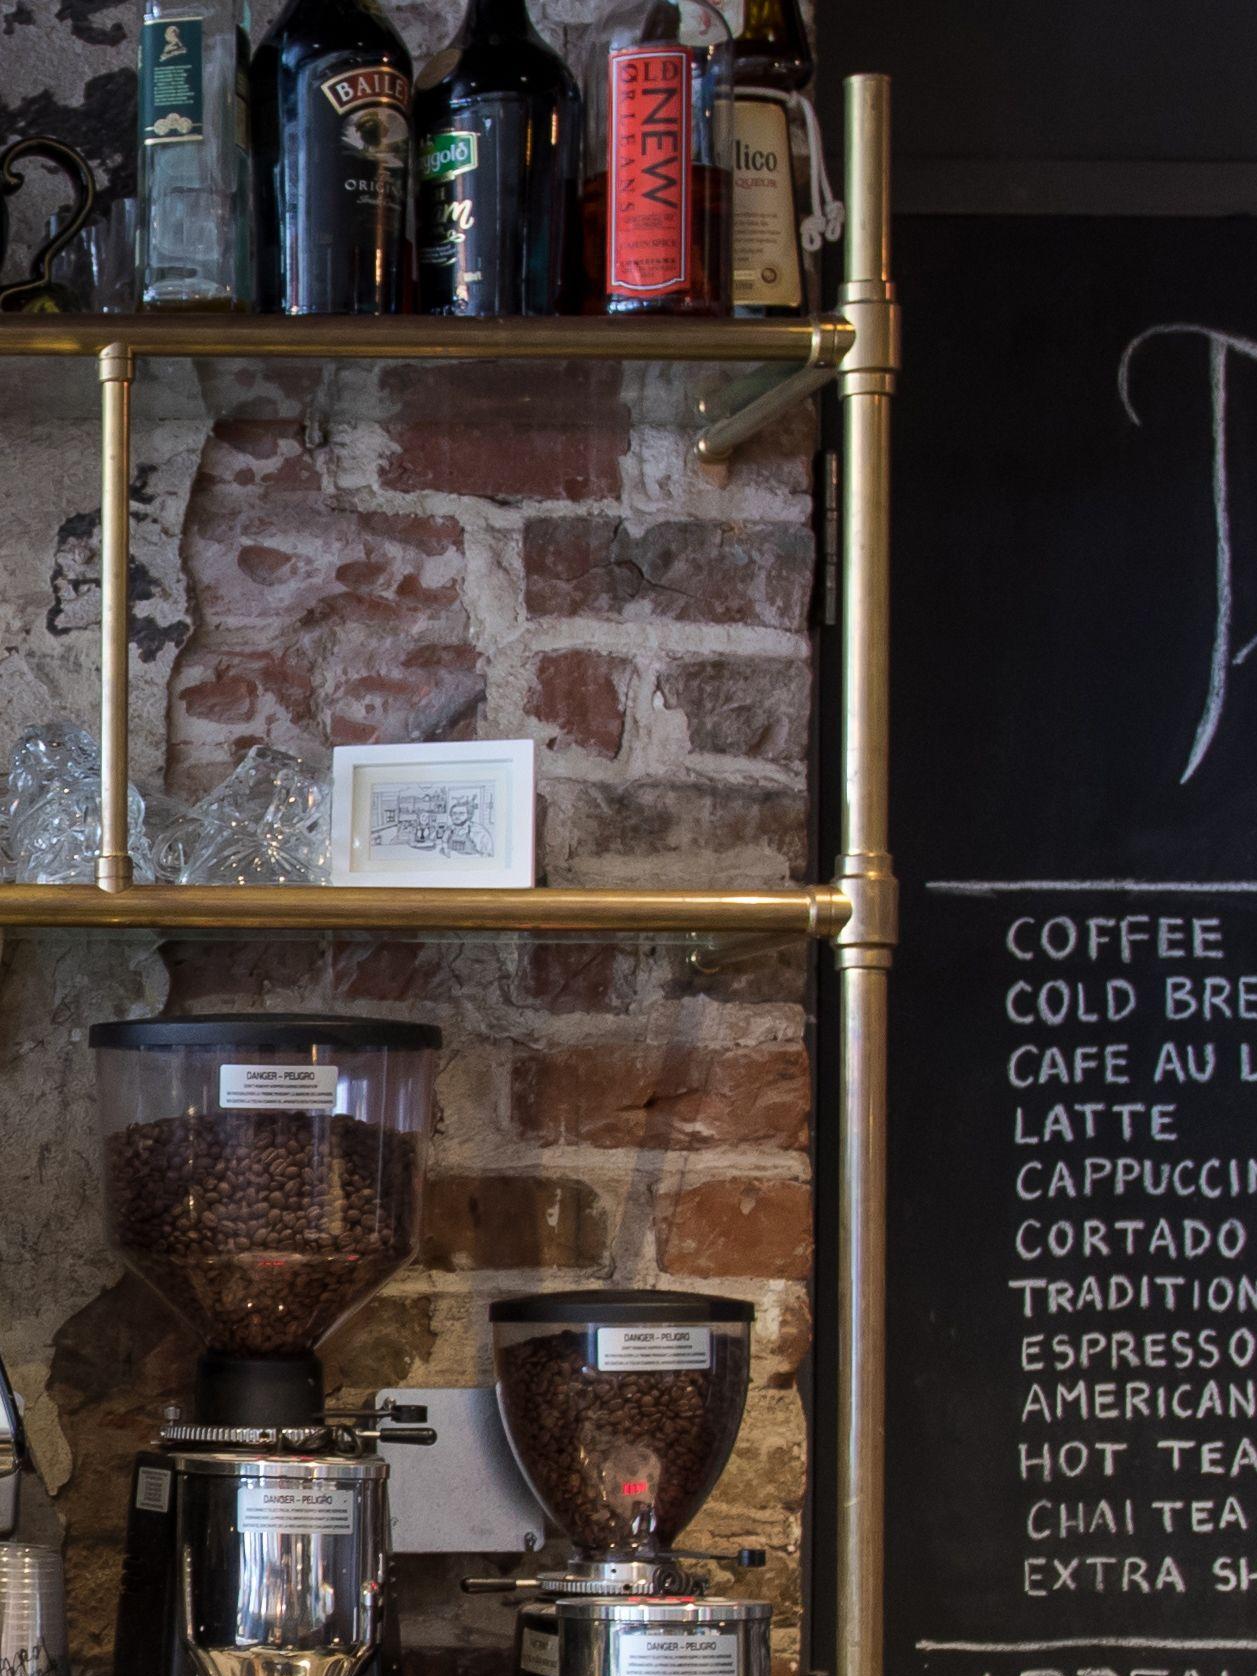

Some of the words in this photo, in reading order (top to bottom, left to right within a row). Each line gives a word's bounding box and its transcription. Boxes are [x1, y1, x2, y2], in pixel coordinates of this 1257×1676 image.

[335, 74, 406, 102] BAILE
[641, 87, 678, 209] NEW
[735, 140, 778, 171] lico
[1006, 915, 1224, 963] COFFEE
[1006, 979, 1136, 1025] COLD
[246, 1071, 278, 1081] DANGER
[1007, 1044, 1130, 1088] CAFE
[1154, 1042, 1215, 1084] AU
[1014, 1103, 1178, 1144] LATTE
[1015, 1218, 1247, 1259] CORTADO
[624, 1332, 655, 1342] DANGER
[1021, 1327, 1256, 1370] ESPRESSO
[1018, 1442, 1127, 1481] HOT
[263, 1494, 295, 1505] DANGER
[1026, 1499, 1134, 1540] CHAI
[1151, 1496, 1248, 1533] TEA
[1024, 1557, 1185, 1597] EXTRA
[646, 1641, 679, 1652] DANGER
